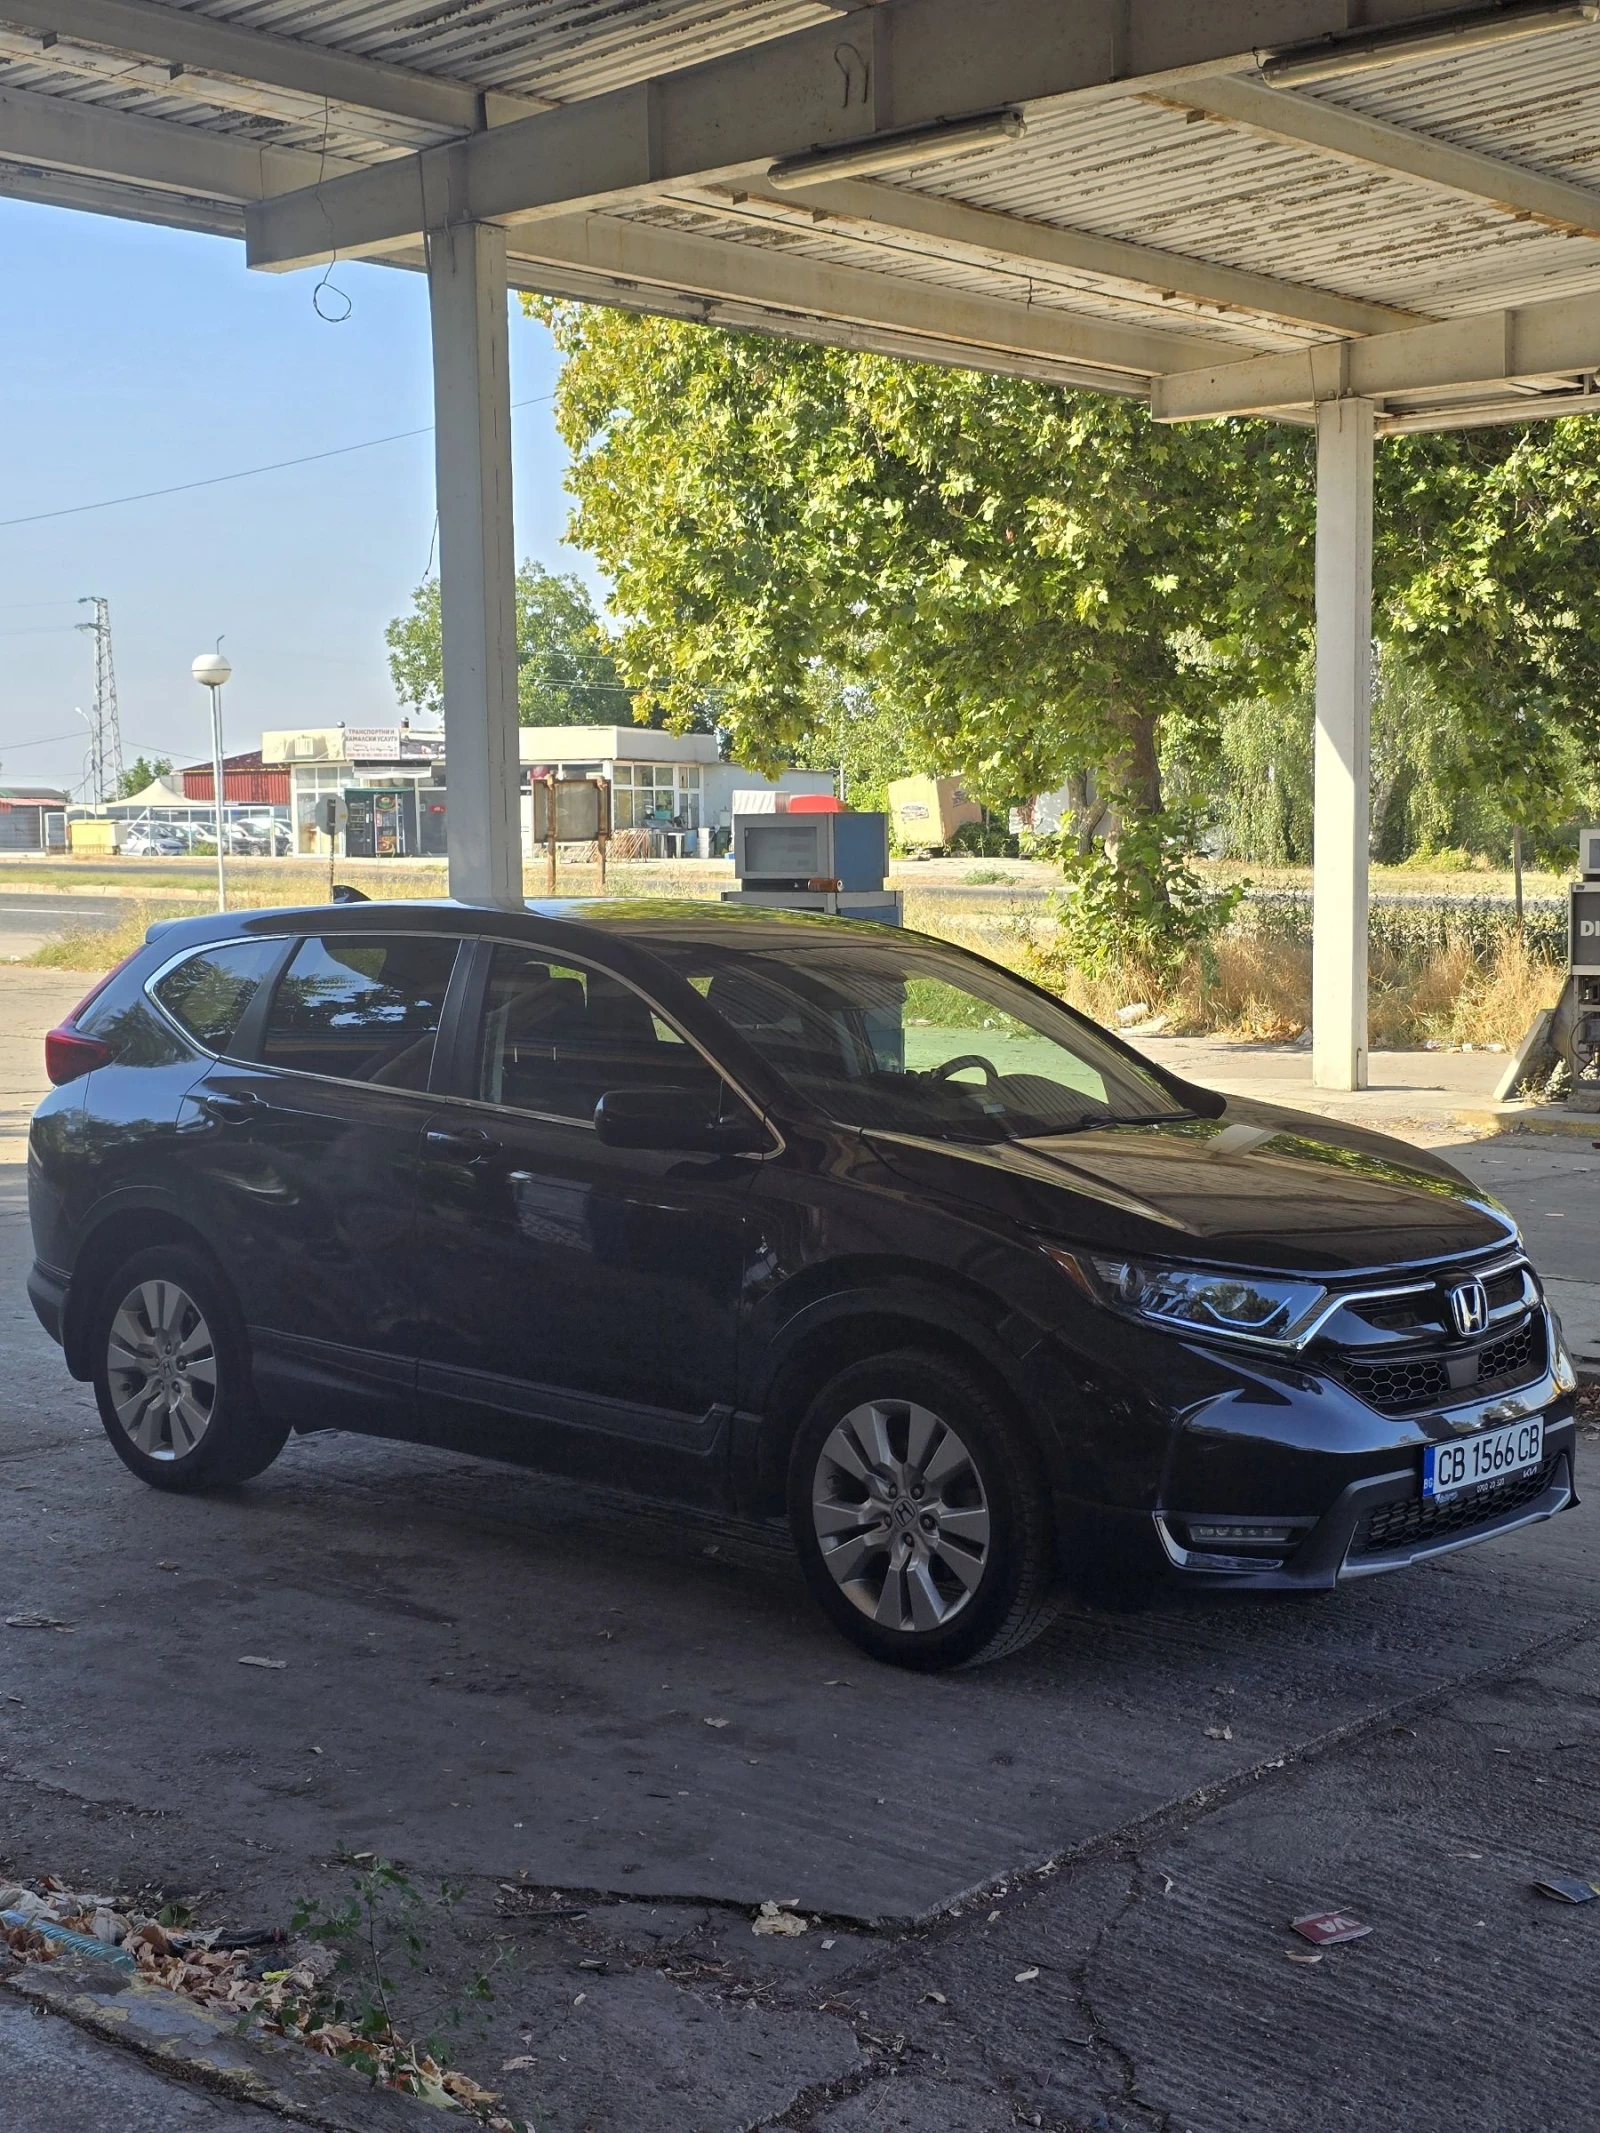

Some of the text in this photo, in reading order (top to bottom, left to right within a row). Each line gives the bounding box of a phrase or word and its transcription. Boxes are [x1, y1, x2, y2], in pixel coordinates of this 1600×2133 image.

[1438, 1424, 1539, 1486] CB 1566 CB
[1423, 1478, 1433, 1490] BG
